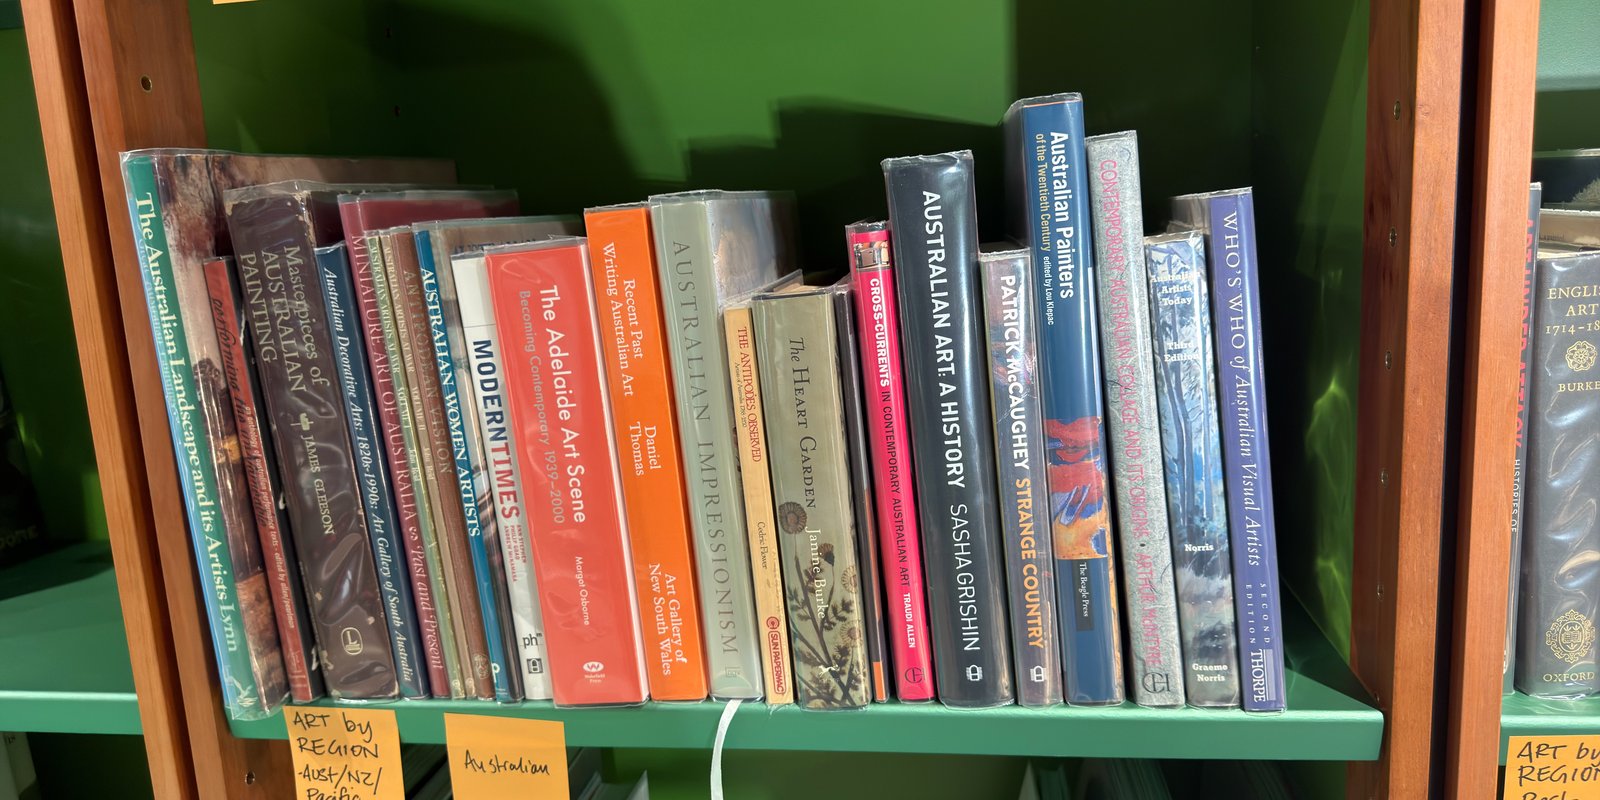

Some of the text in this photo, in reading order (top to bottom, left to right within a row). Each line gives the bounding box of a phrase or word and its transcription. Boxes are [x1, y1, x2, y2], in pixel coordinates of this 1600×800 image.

[134, 192, 161, 240] The
[1034, 133, 1053, 252] of the Twentieth Century
[1048, 130, 1078, 299] Australian Painters
[144, 242, 183, 354] Australian
[368, 245, 386, 300] AUSTRALIAN
[383, 246, 400, 300] AUSTRALIAN
[1041, 256, 1055, 325] edited by Lou Klepac
[1161, 285, 1193, 294] Artists
[1161, 296, 1193, 306] Today
[1547, 285, 1600, 300] ENGLI
[239, 250, 278, 364] PAINTING
[260, 246, 306, 394] AUSTRALIAN
[280, 242, 329, 389] Masterpieces of
[379, 302, 394, 339] ARTISTS
[393, 300, 408, 339] ARTISTS
[515, 289, 540, 353] Becoming
[599, 242, 636, 396] Writing Australian Art
[622, 278, 646, 359] Recent Past
[1565, 303, 1599, 316] ART
[387, 340, 396, 353] AT
[389, 353, 400, 373] WAR
[401, 340, 411, 352] AT
[404, 352, 415, 372] WAR
[919, 189, 966, 489] AUSTRALIAN ART: A HISTORY
[1098, 159, 1150, 538] CONTEMPORARY AUSTRALIAN COLLAGE AND ITS ORIGINS
[1167, 341, 1195, 350] Third
[350, 233, 417, 520] MINIATURE ART OF AUSTRALIA
[402, 268, 453, 473] ANTIPODEAN VISION
[522, 355, 554, 446] Contemporary
[737, 326, 762, 462] THE ANTIPODES OBSERVED
[999, 274, 1030, 470] PATRICK McCAUGHEY
[1221, 211, 1265, 566] WHO'S WHO of Australian Visual Artists
[166, 356, 206, 467] Landscape
[419, 266, 481, 537] AUSTRALIAN WOMEN ARTISTS
[538, 284, 593, 523] The Adelaide Art Scene
[788, 337, 823, 509] The HEART GARDEN
[869, 277, 909, 586] CROSS-CURRENTS IN CONTEMPORARY AUSTRALIAN ART
[323, 266, 414, 681] Australian Decorative Arts: 1820s-1990s: Art Gallery of South Australia
[627, 421, 648, 476] Thomas
[643, 425, 662, 469] Daniel
[672, 239, 740, 654] AUSTRALIAN IMPRESSIONISM
[190, 466, 214, 509] and
[300, 433, 334, 535] JAMES GLEESON
[198, 508, 219, 532] its
[756, 521, 770, 569] Cedric Flower
[1184, 543, 1214, 552] Norris
[203, 532, 233, 601] Artists
[572, 555, 593, 625] Margot Osborne
[804, 525, 829, 618] Janine Burke
[948, 503, 981, 651] SASHA GRISHIN
[1015, 477, 1043, 648] STRANGE COUNTRY
[1076, 562, 1090, 617] The Beagle Press
[1134, 551, 1156, 604] ARTHUR
[215, 602, 243, 652] Lynn
[409, 544, 445, 670] Past and Present
[648, 563, 675, 675] New South Wales
[664, 572, 687, 664] Art Gallery of
[902, 592, 915, 648] TRAUDI ALLEN
[1244, 583, 1256, 643] EDITION
[1259, 583, 1270, 642] SECOND
[770, 632, 784, 691] SUN PAPERMAC
[1192, 663, 1228, 672] Graeme
[1197, 674, 1226, 682] Norris
[1248, 649, 1266, 702] THORPE
[1543, 671, 1595, 682] OXFORD
[293, 711, 373, 743] ART by
[296, 737, 379, 758] REGION
[1517, 741, 1568, 763] ART
[465, 750, 550, 775] Australian
